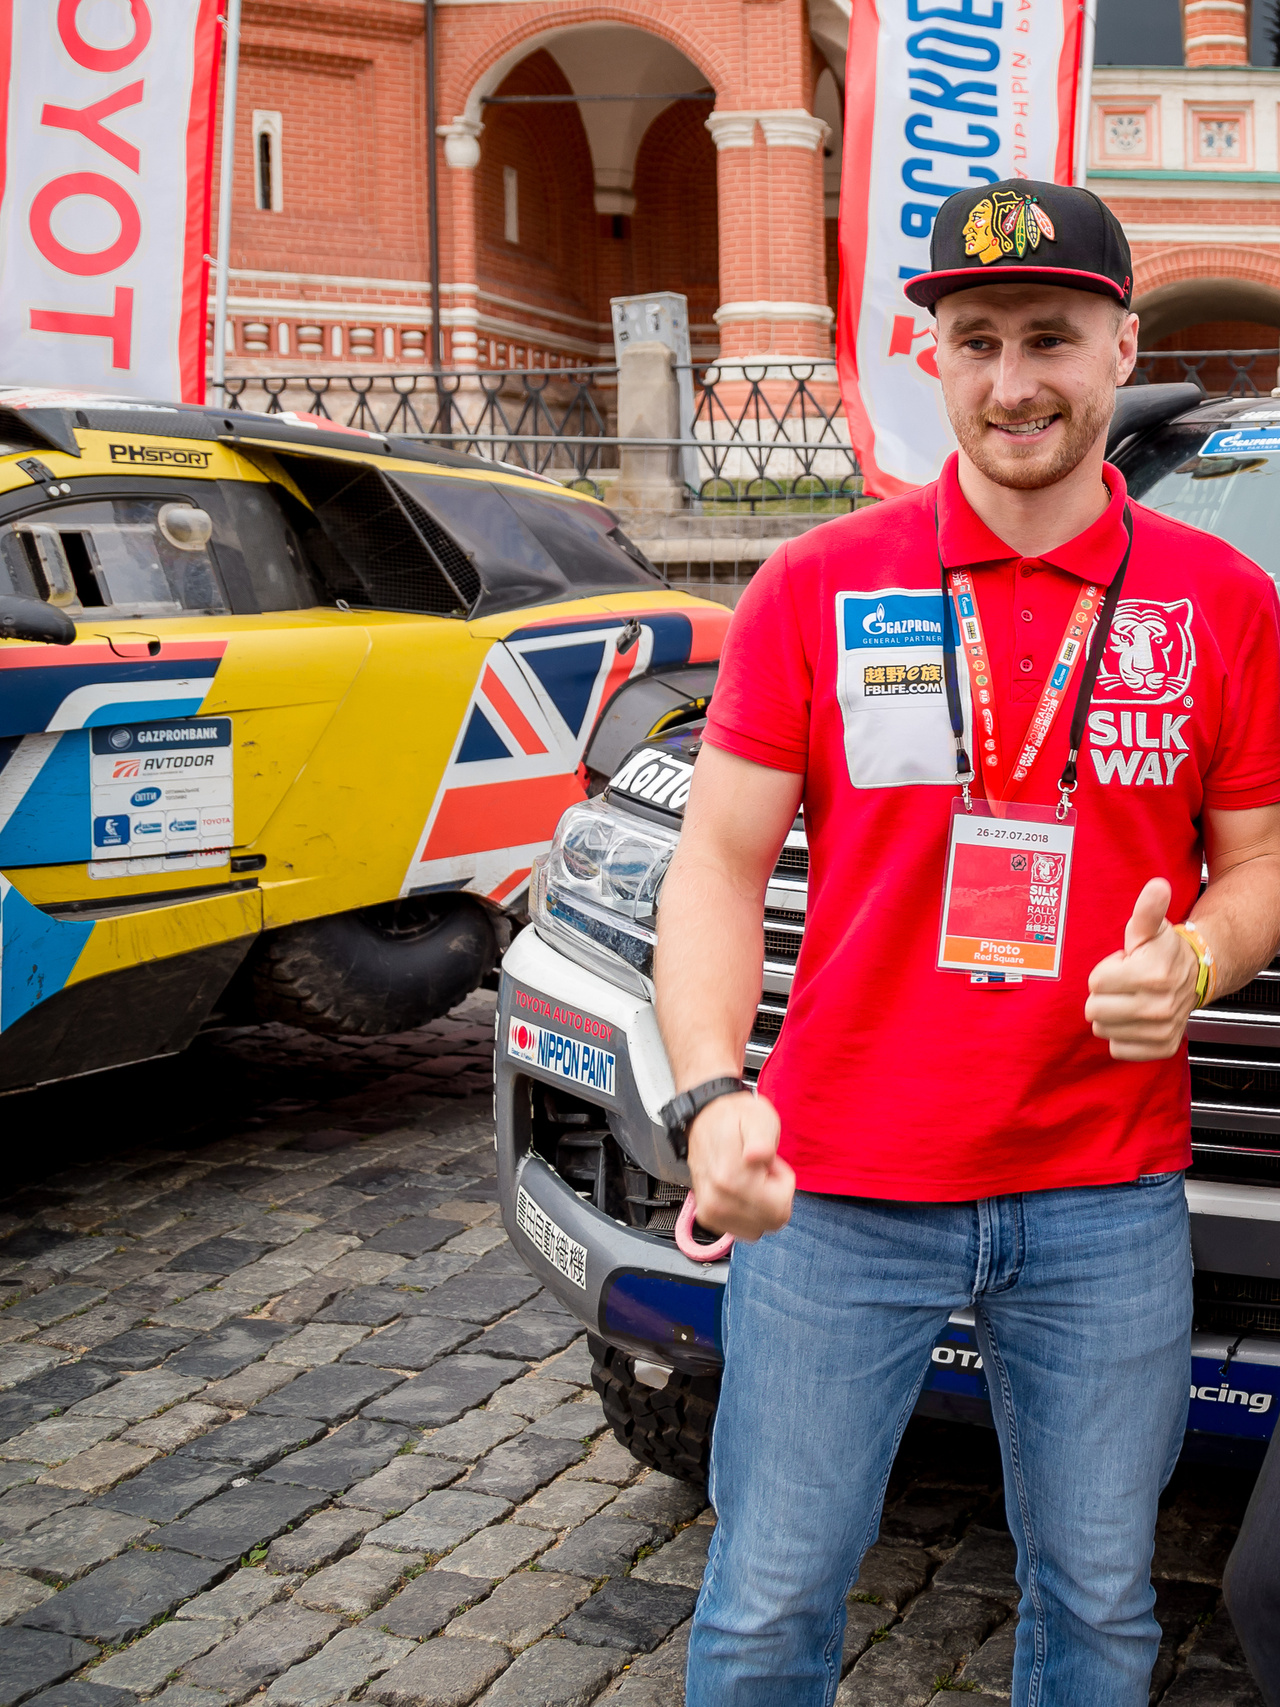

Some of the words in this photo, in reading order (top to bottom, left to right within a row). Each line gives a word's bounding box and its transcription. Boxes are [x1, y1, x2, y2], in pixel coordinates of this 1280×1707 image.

[886, 619, 941, 634] GAZPROM
[862, 636, 900, 644] GENERAL
[904, 635, 943, 643] PARTNER
[864, 664, 942, 683] 越野e族
[865, 683, 942, 696] FBLIFE.COM
[137, 727, 218, 743] GAZPROMBANK
[1087, 710, 1191, 750] SILK
[143, 754, 214, 770] AVTODOR
[1089, 749, 1189, 786] WAY
[134, 791, 157, 802] ОПТИ
[202, 817, 231, 826] TOYOTA
[976, 827, 1049, 843] 26-27.07.2018
[1029, 885, 1059, 897] SILK
[1029, 895, 1058, 907] WAY
[1027, 905, 1057, 916] RALLY
[1026, 913, 1057, 925] 2018
[980, 941, 1021, 955] Photo
[973, 952, 992, 961] Red
[993, 953, 1025, 965] Square
[515, 990, 551, 1018] TOYOTA
[553, 1006, 583, 1030] AUTO
[584, 1018, 613, 1042] BODY
[537, 1029, 581, 1079] NIPPON
[581, 1046, 614, 1093] PAINT
